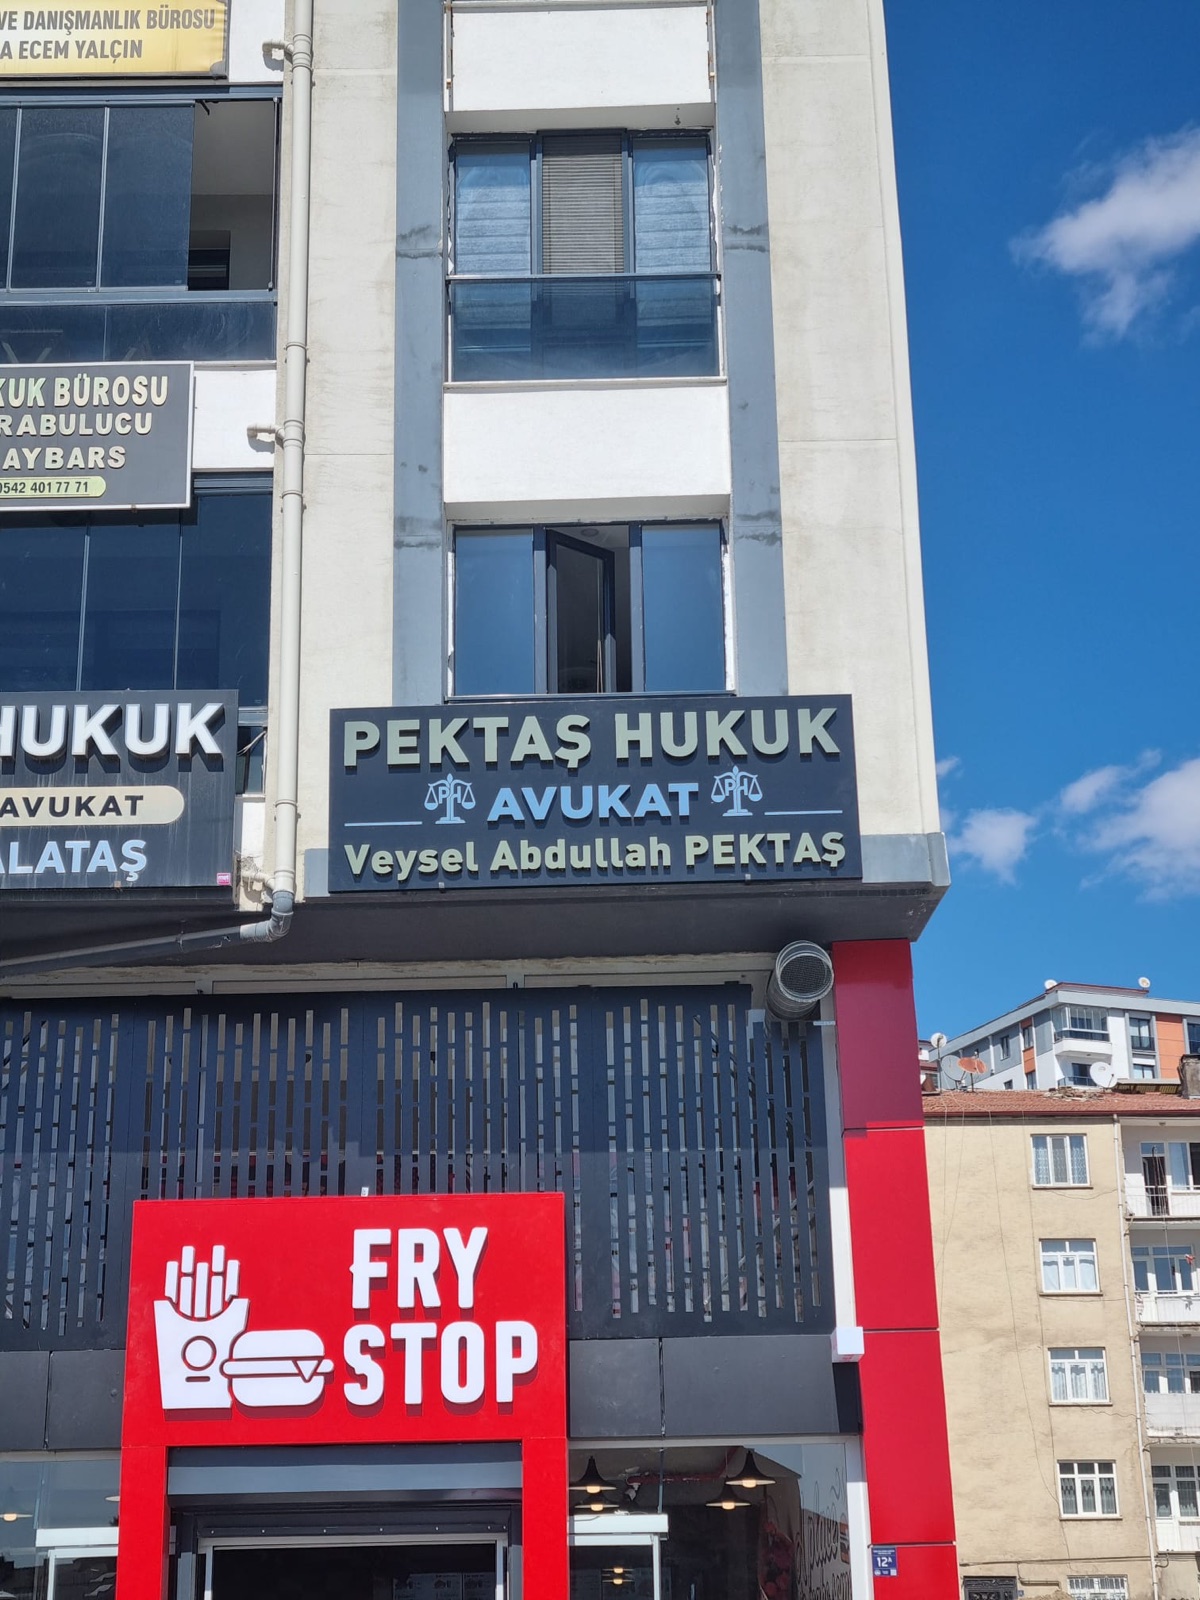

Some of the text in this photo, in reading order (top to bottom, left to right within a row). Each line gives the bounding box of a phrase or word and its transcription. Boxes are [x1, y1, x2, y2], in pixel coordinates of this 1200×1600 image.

[23, 10, 141, 36] DANIŞMANLIK
[146, 4, 216, 30] BÜROSU
[18, 40, 69, 60] ECEM
[75, 39, 143, 64] YALÇIN
[54, 373, 169, 408] BÜROSU
[2, 446, 127, 471] AYBARS
[30, 481, 52, 493] 401
[55, 481, 70, 493] 77
[74, 480, 89, 492] 71
[343, 707, 841, 769] PEKTAŞ HUKUK
[0, 794, 144, 818] AVUKAT
[486, 782, 699, 822] AVUKAT
[0, 839, 147, 882] LATAŞ
[343, 831, 847, 881] Veysel Abdullah PEKTAŞ
[348, 1226, 488, 1310] FRY
[343, 1320, 539, 1406] STOP
